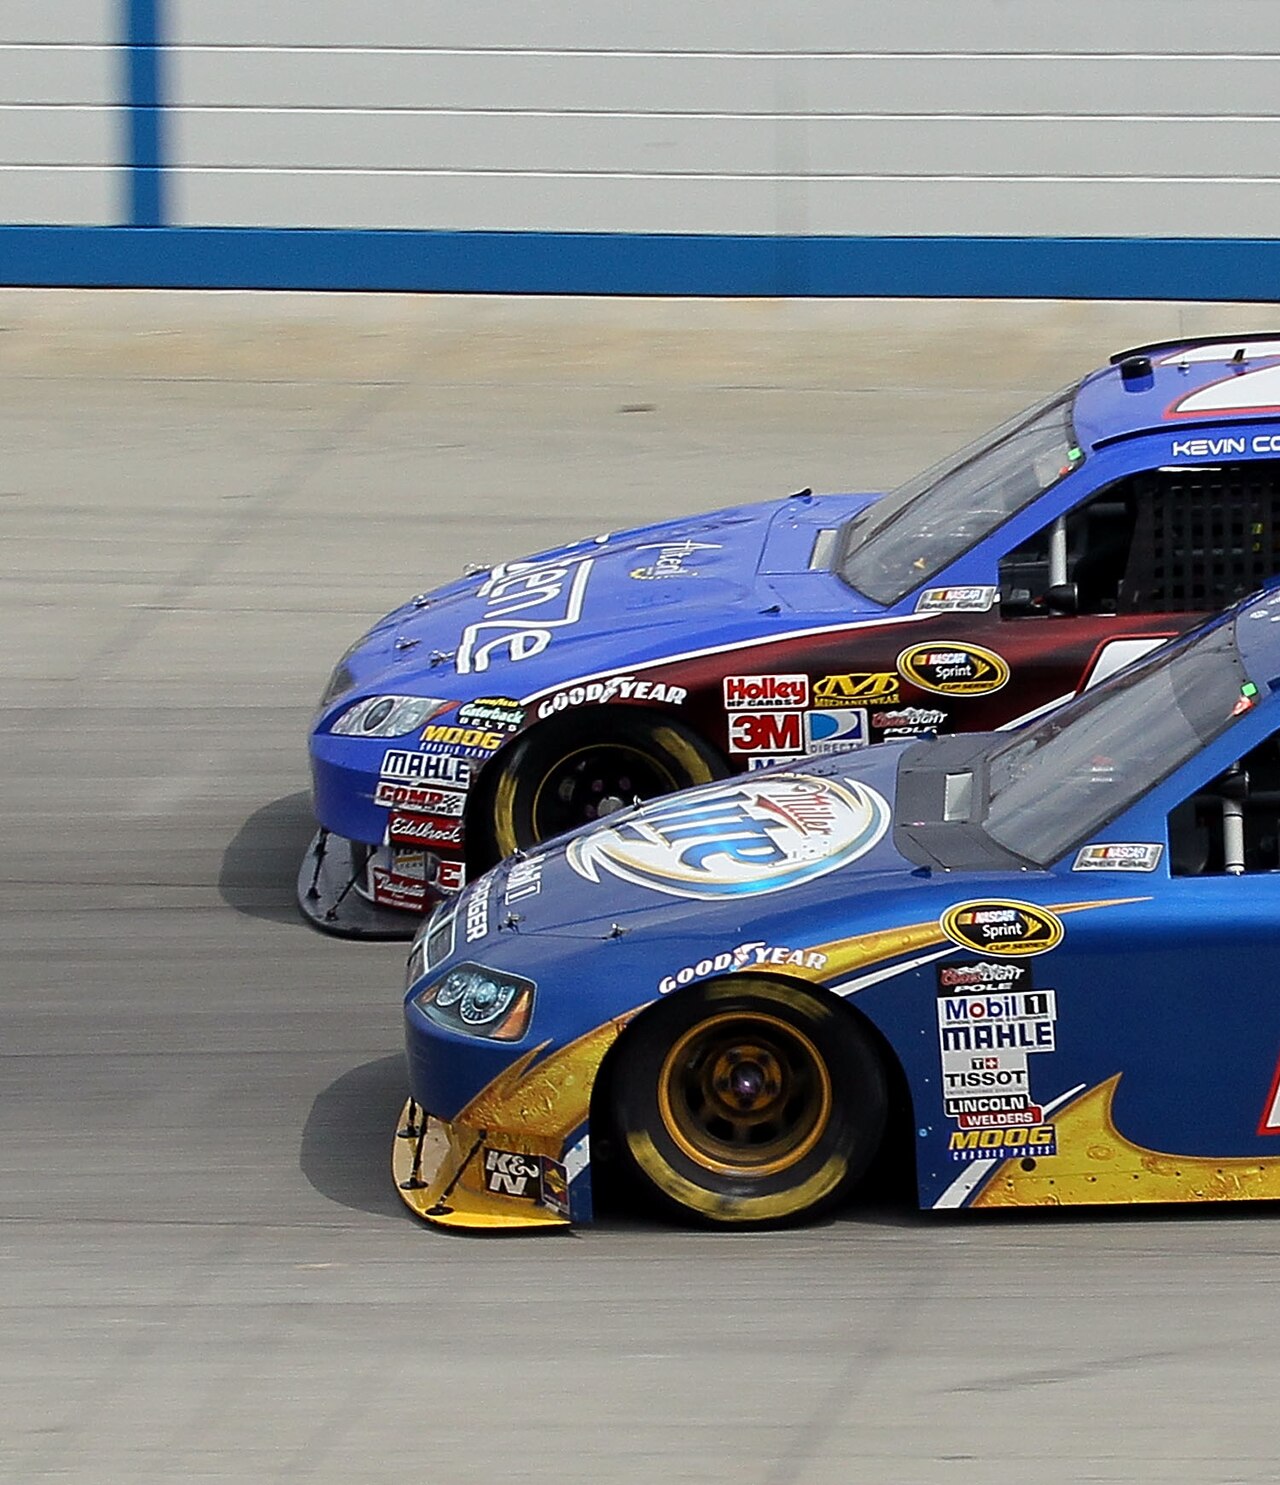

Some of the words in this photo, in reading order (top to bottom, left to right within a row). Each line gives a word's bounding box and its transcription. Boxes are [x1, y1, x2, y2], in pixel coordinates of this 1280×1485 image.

[1172, 437, 1246, 457] KEVIN
[945, 589, 982, 600] NASCAR
[929, 653, 967, 665] NASCAR
[935, 665, 972, 680] Sprint
[538, 676, 688, 719] GOODYEAR
[727, 678, 806, 705] Holley
[459, 716, 517, 732] BELTS
[732, 714, 800, 750] 3M
[419, 725, 505, 750] MOOG
[383, 751, 471, 783] MAHLE
[380, 785, 443, 805] COMP
[390, 817, 461, 843] Edelbrock
[1106, 848, 1145, 858] NASCAR
[975, 910, 1016, 923] NASCAR
[982, 923, 1022, 940] Sprint
[658, 941, 828, 995] GOODYEAR
[954, 983, 1013, 993] POLE
[945, 995, 1018, 1020] Mobil
[942, 1022, 1053, 1052] MAHLE
[944, 1070, 1026, 1088] TISSOT
[949, 1097, 1026, 1114] LINCOLN
[967, 1112, 1034, 1126] WELDERS
[948, 1126, 1054, 1150] MOOG
[485, 1150, 540, 1196] K&N
